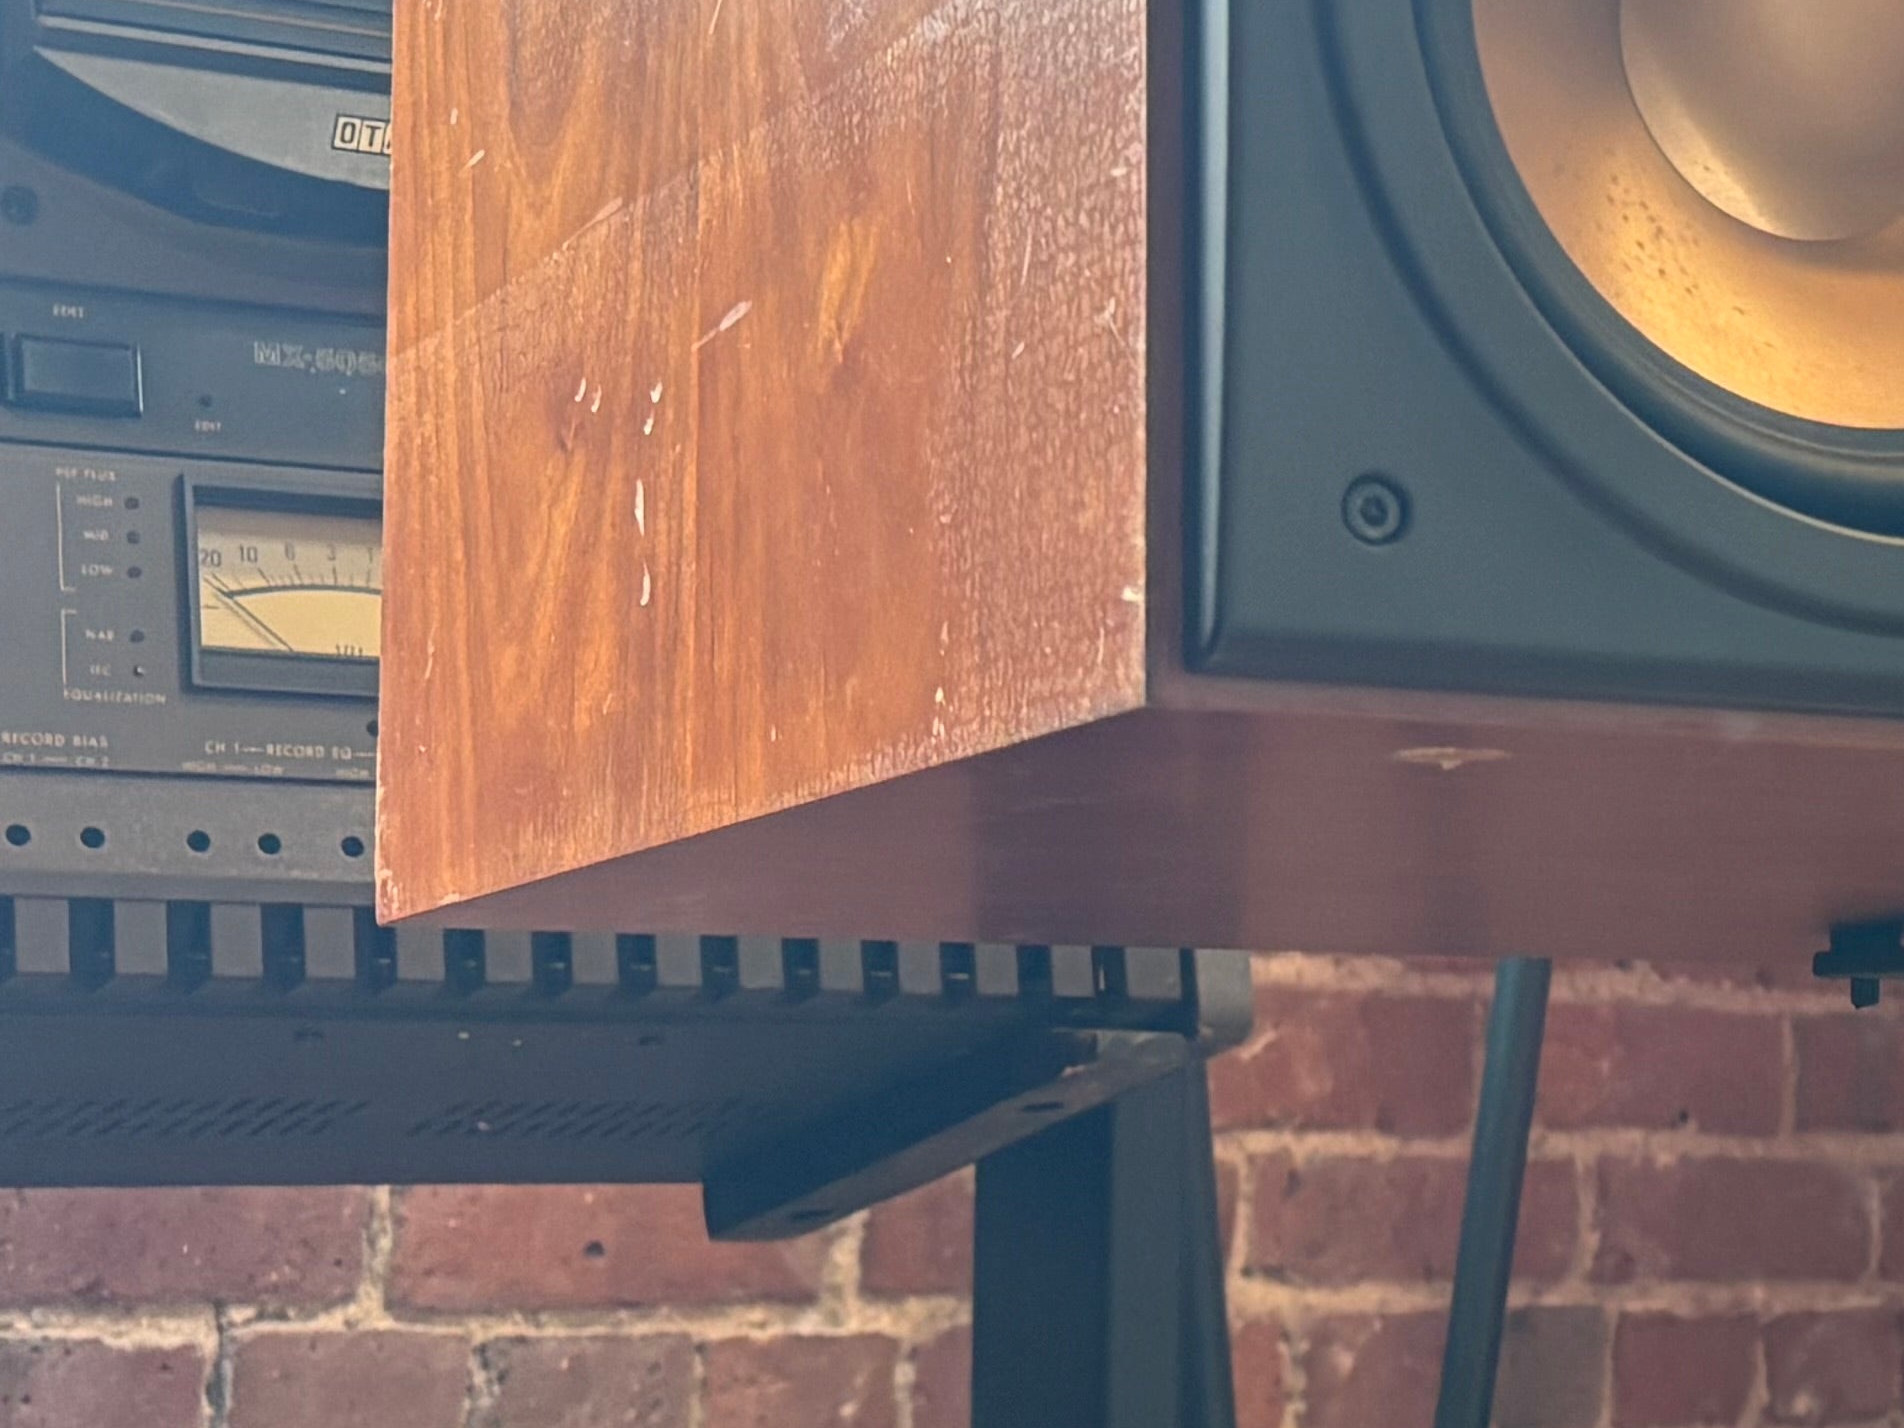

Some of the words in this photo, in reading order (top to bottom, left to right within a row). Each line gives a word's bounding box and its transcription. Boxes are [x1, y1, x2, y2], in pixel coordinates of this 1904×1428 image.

[340, 121, 391, 149] OT
[201, 549, 222, 568] 20
[239, 544, 258, 563] 10
[81, 563, 114, 576] LOW
[1, 730, 65, 748] RECORD
[204, 740, 226, 754] CH
